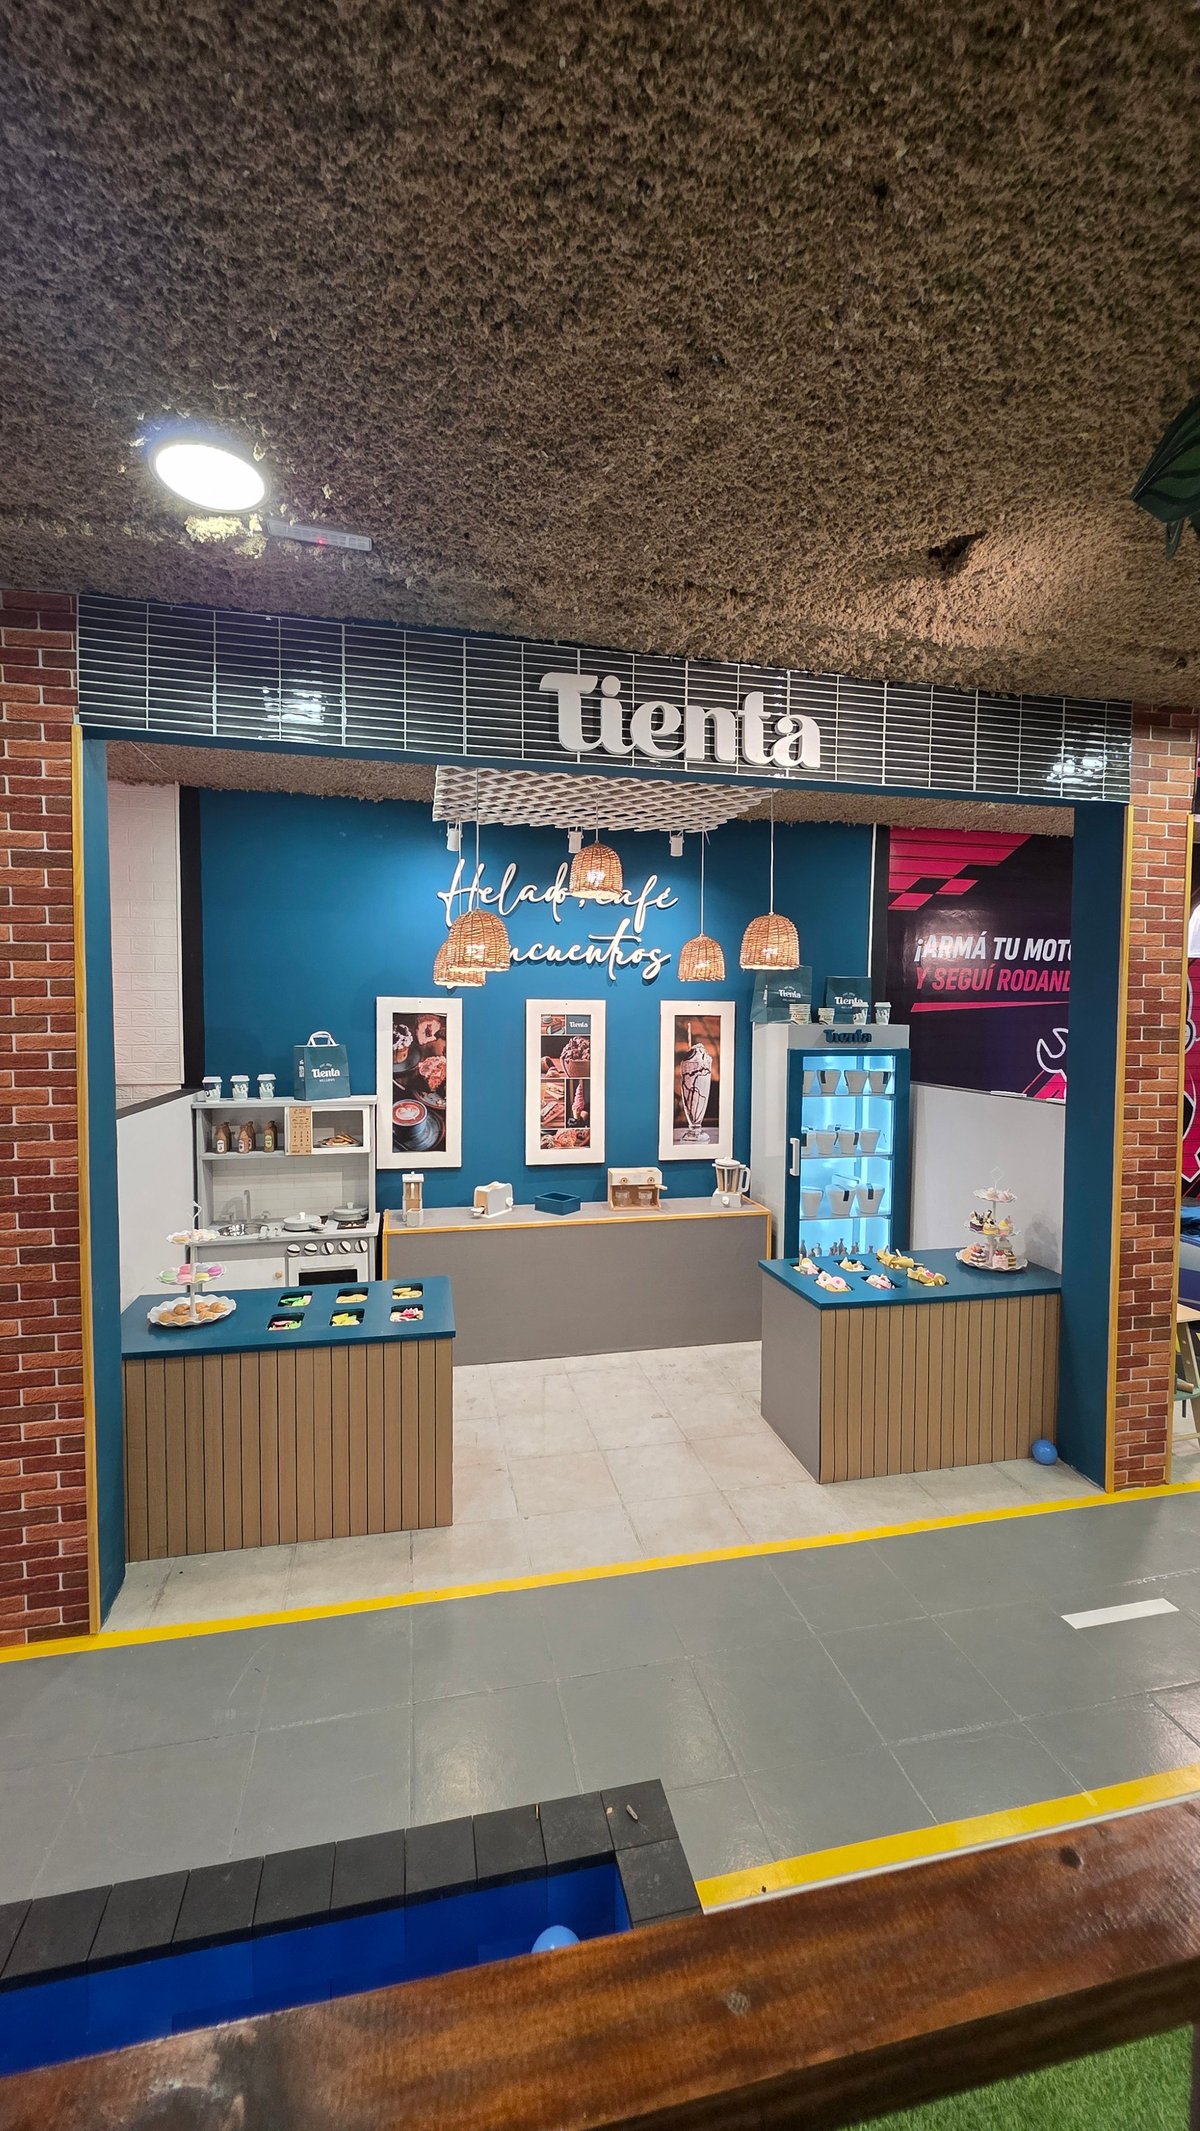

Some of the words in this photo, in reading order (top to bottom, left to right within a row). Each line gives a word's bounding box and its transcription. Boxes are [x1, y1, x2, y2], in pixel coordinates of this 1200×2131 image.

[539, 671, 821, 769] Tienta
[509, 918, 672, 981] ncuentros
[914, 931, 988, 962] ¡ARMÁ
[993, 937, 1021, 961] TU
[1023, 938, 1072, 962] MOT
[915, 966, 930, 990] Y
[931, 963, 996, 991] SEGUÍ
[823, 1028, 873, 1043] Tienta
[311, 1068, 341, 1078] Tienta
